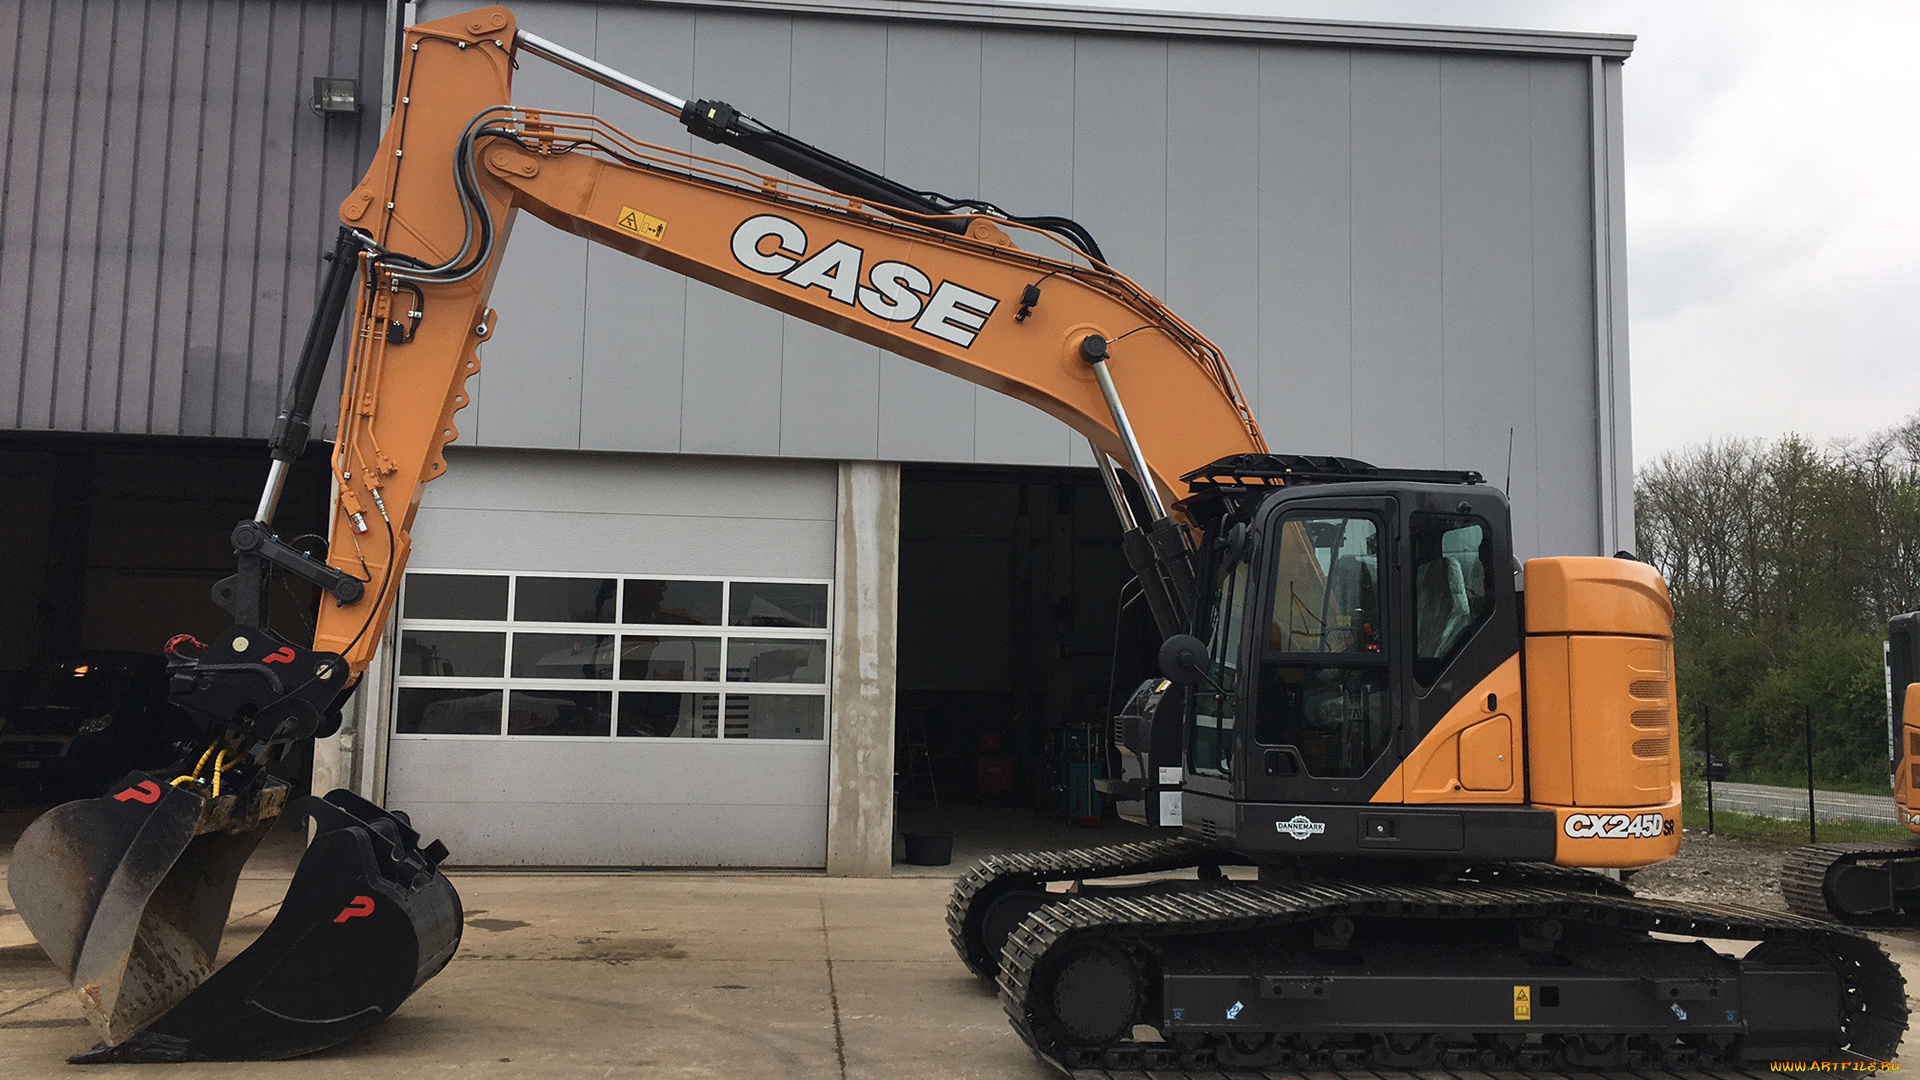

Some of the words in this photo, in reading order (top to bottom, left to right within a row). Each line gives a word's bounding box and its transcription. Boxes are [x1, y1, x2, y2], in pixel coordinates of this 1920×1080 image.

[731, 214, 1000, 349] CASE
[1278, 822, 1323, 830] DANNEMARK
[1564, 813, 1662, 838] CX245D
